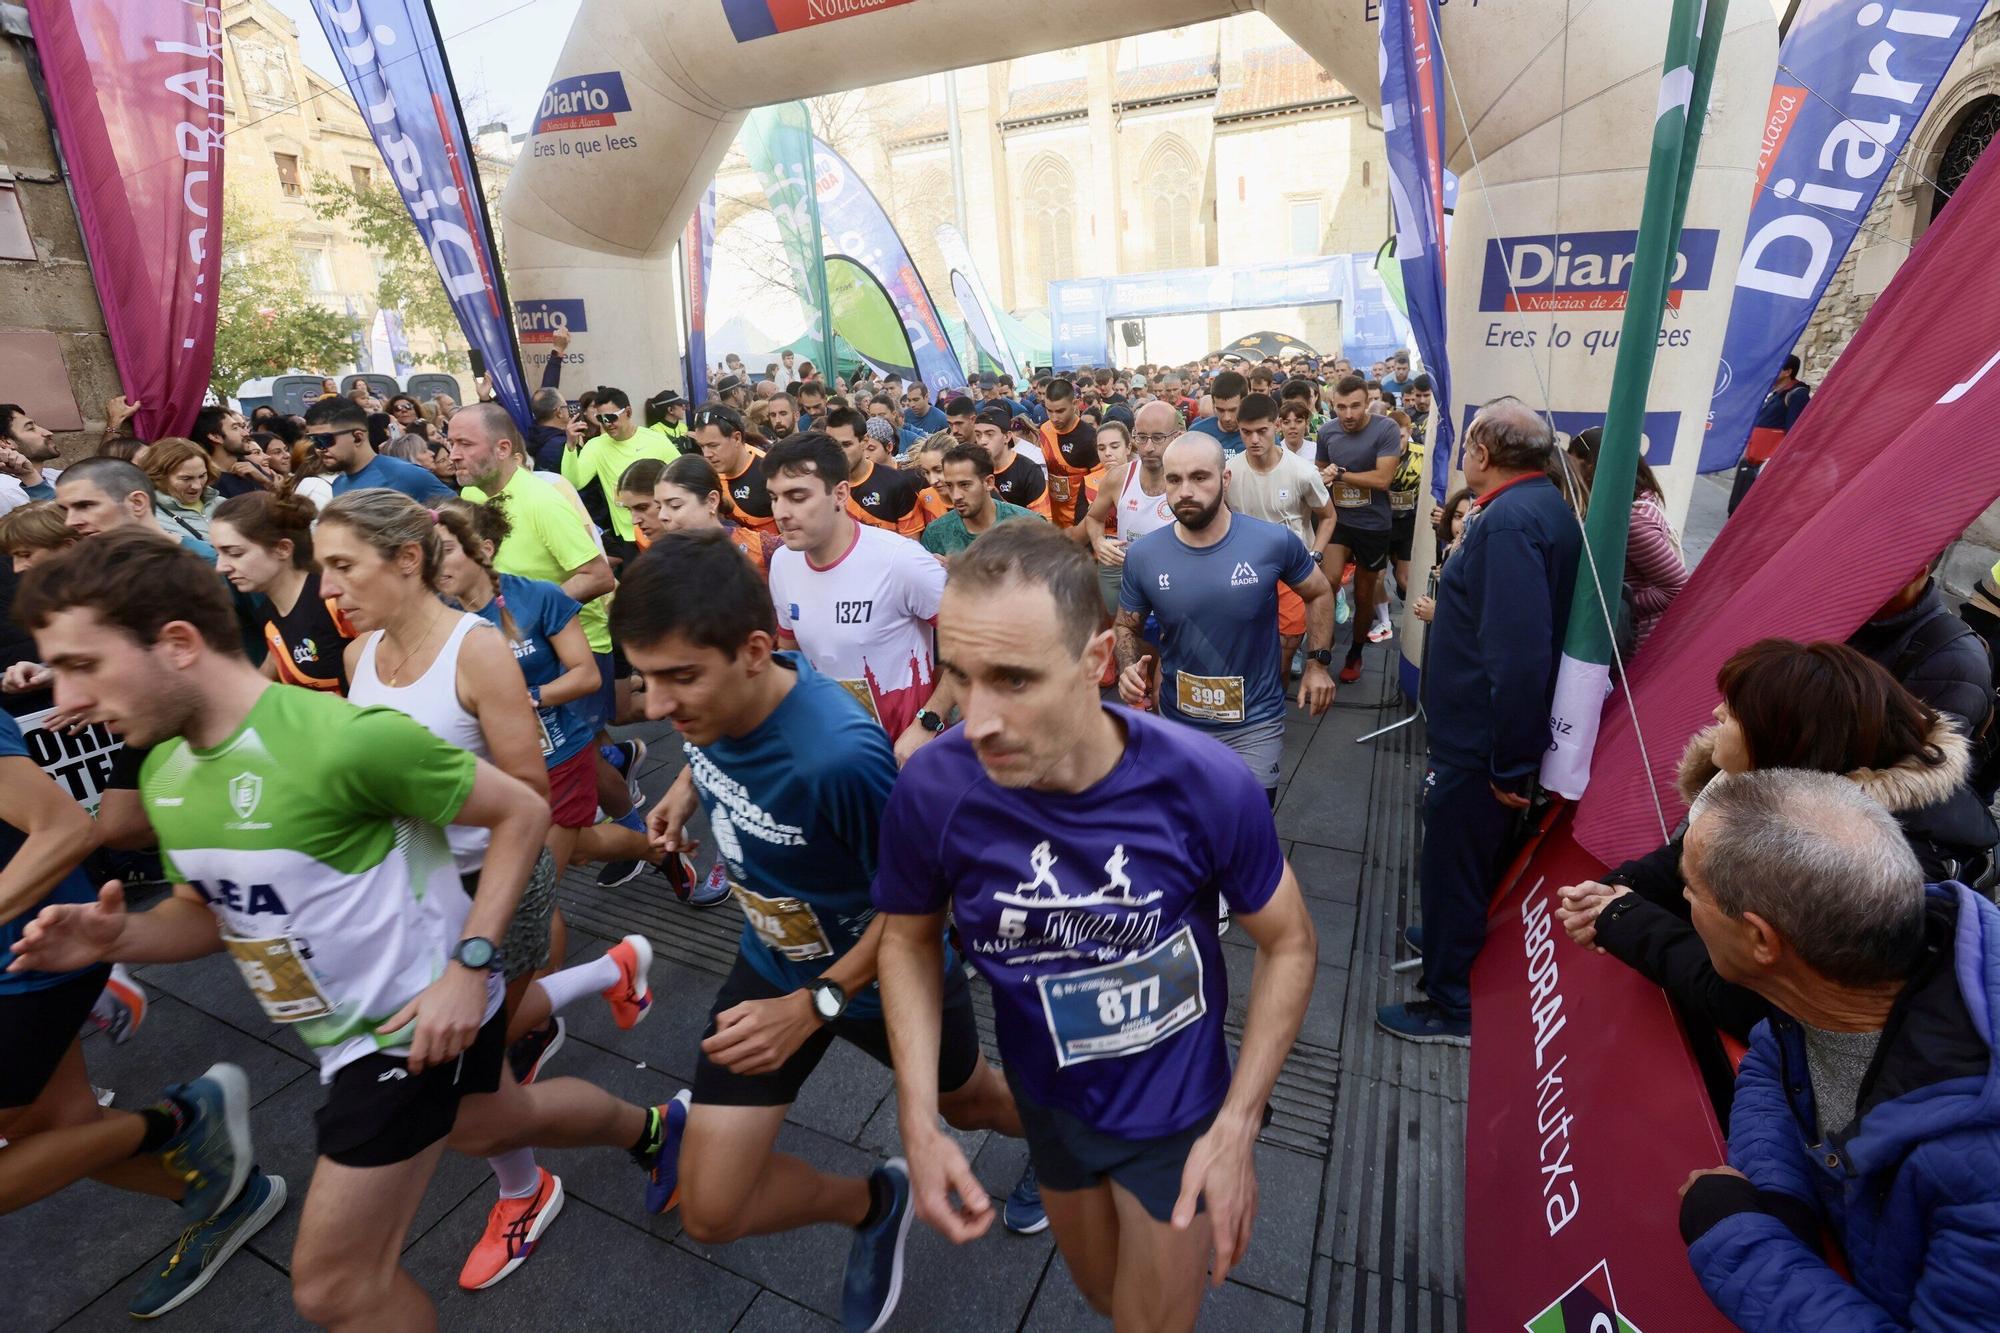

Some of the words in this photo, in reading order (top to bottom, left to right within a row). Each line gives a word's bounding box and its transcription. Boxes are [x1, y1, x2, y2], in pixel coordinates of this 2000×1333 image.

[541, 80, 609, 119] Diario
[534, 141, 556, 157] Eres
[559, 139, 570, 155] lo
[575, 140, 602, 158] que
[606, 134, 638, 152] lees
[1508, 240, 1688, 288] Diar
[1527, 296, 1584, 310] Noticias
[1591, 295, 1608, 310] de
[1485, 323, 1537, 348] Eres
[1547, 323, 1572, 348] lo
[1584, 329, 1619, 356] qu
[1342, 489, 1361, 498] 333
[1231, 577, 1258, 587] MADEN
[835, 601, 872, 624] 1327
[1191, 686, 1225, 706] 399
[1522, 875, 1568, 1070] LABORAL
[1096, 974, 1161, 1026] 877
